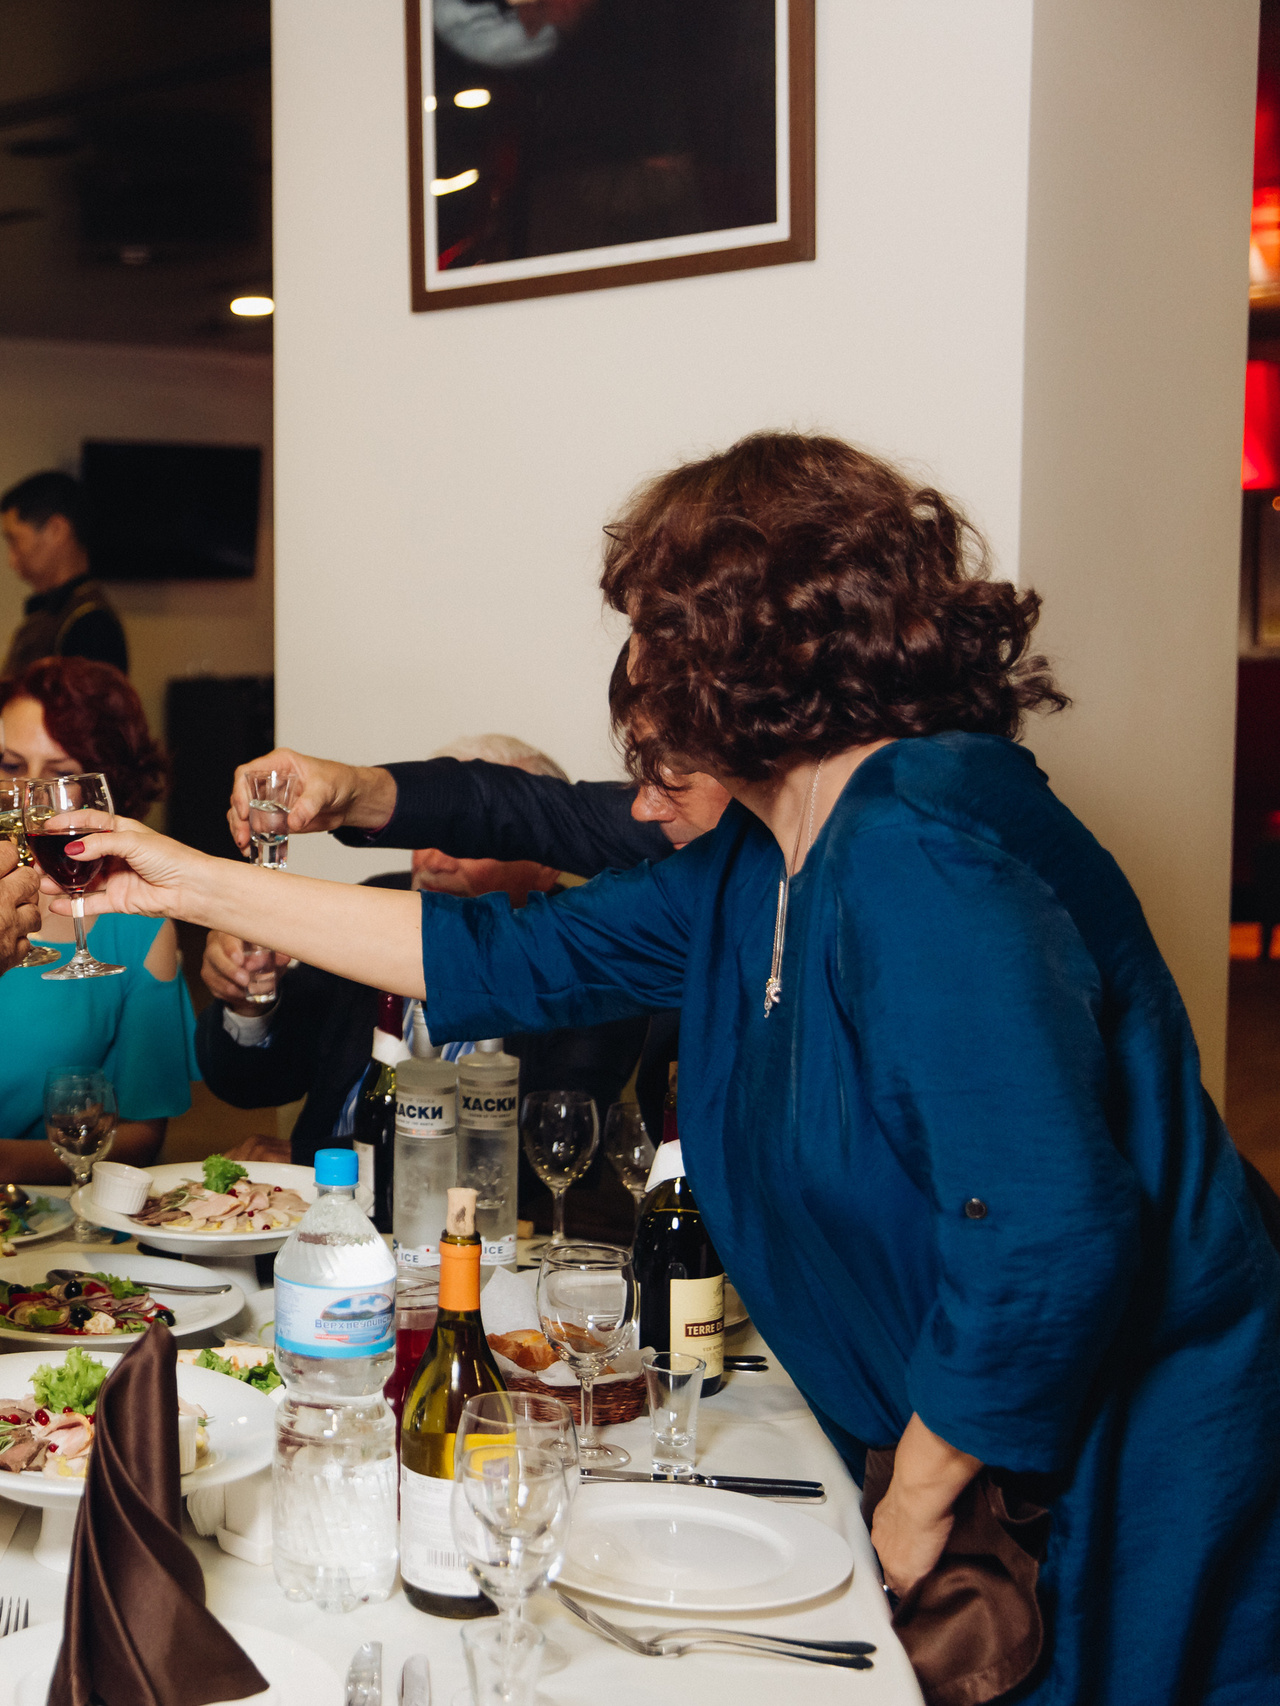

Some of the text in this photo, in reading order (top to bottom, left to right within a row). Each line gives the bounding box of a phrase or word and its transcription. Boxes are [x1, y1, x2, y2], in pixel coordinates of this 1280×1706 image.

[462, 1095, 516, 1112] ХАСКИ
[484, 1245, 504, 1255] ICE
[400, 1252, 419, 1264] ICE
[687, 1324, 715, 1335] TERRE
